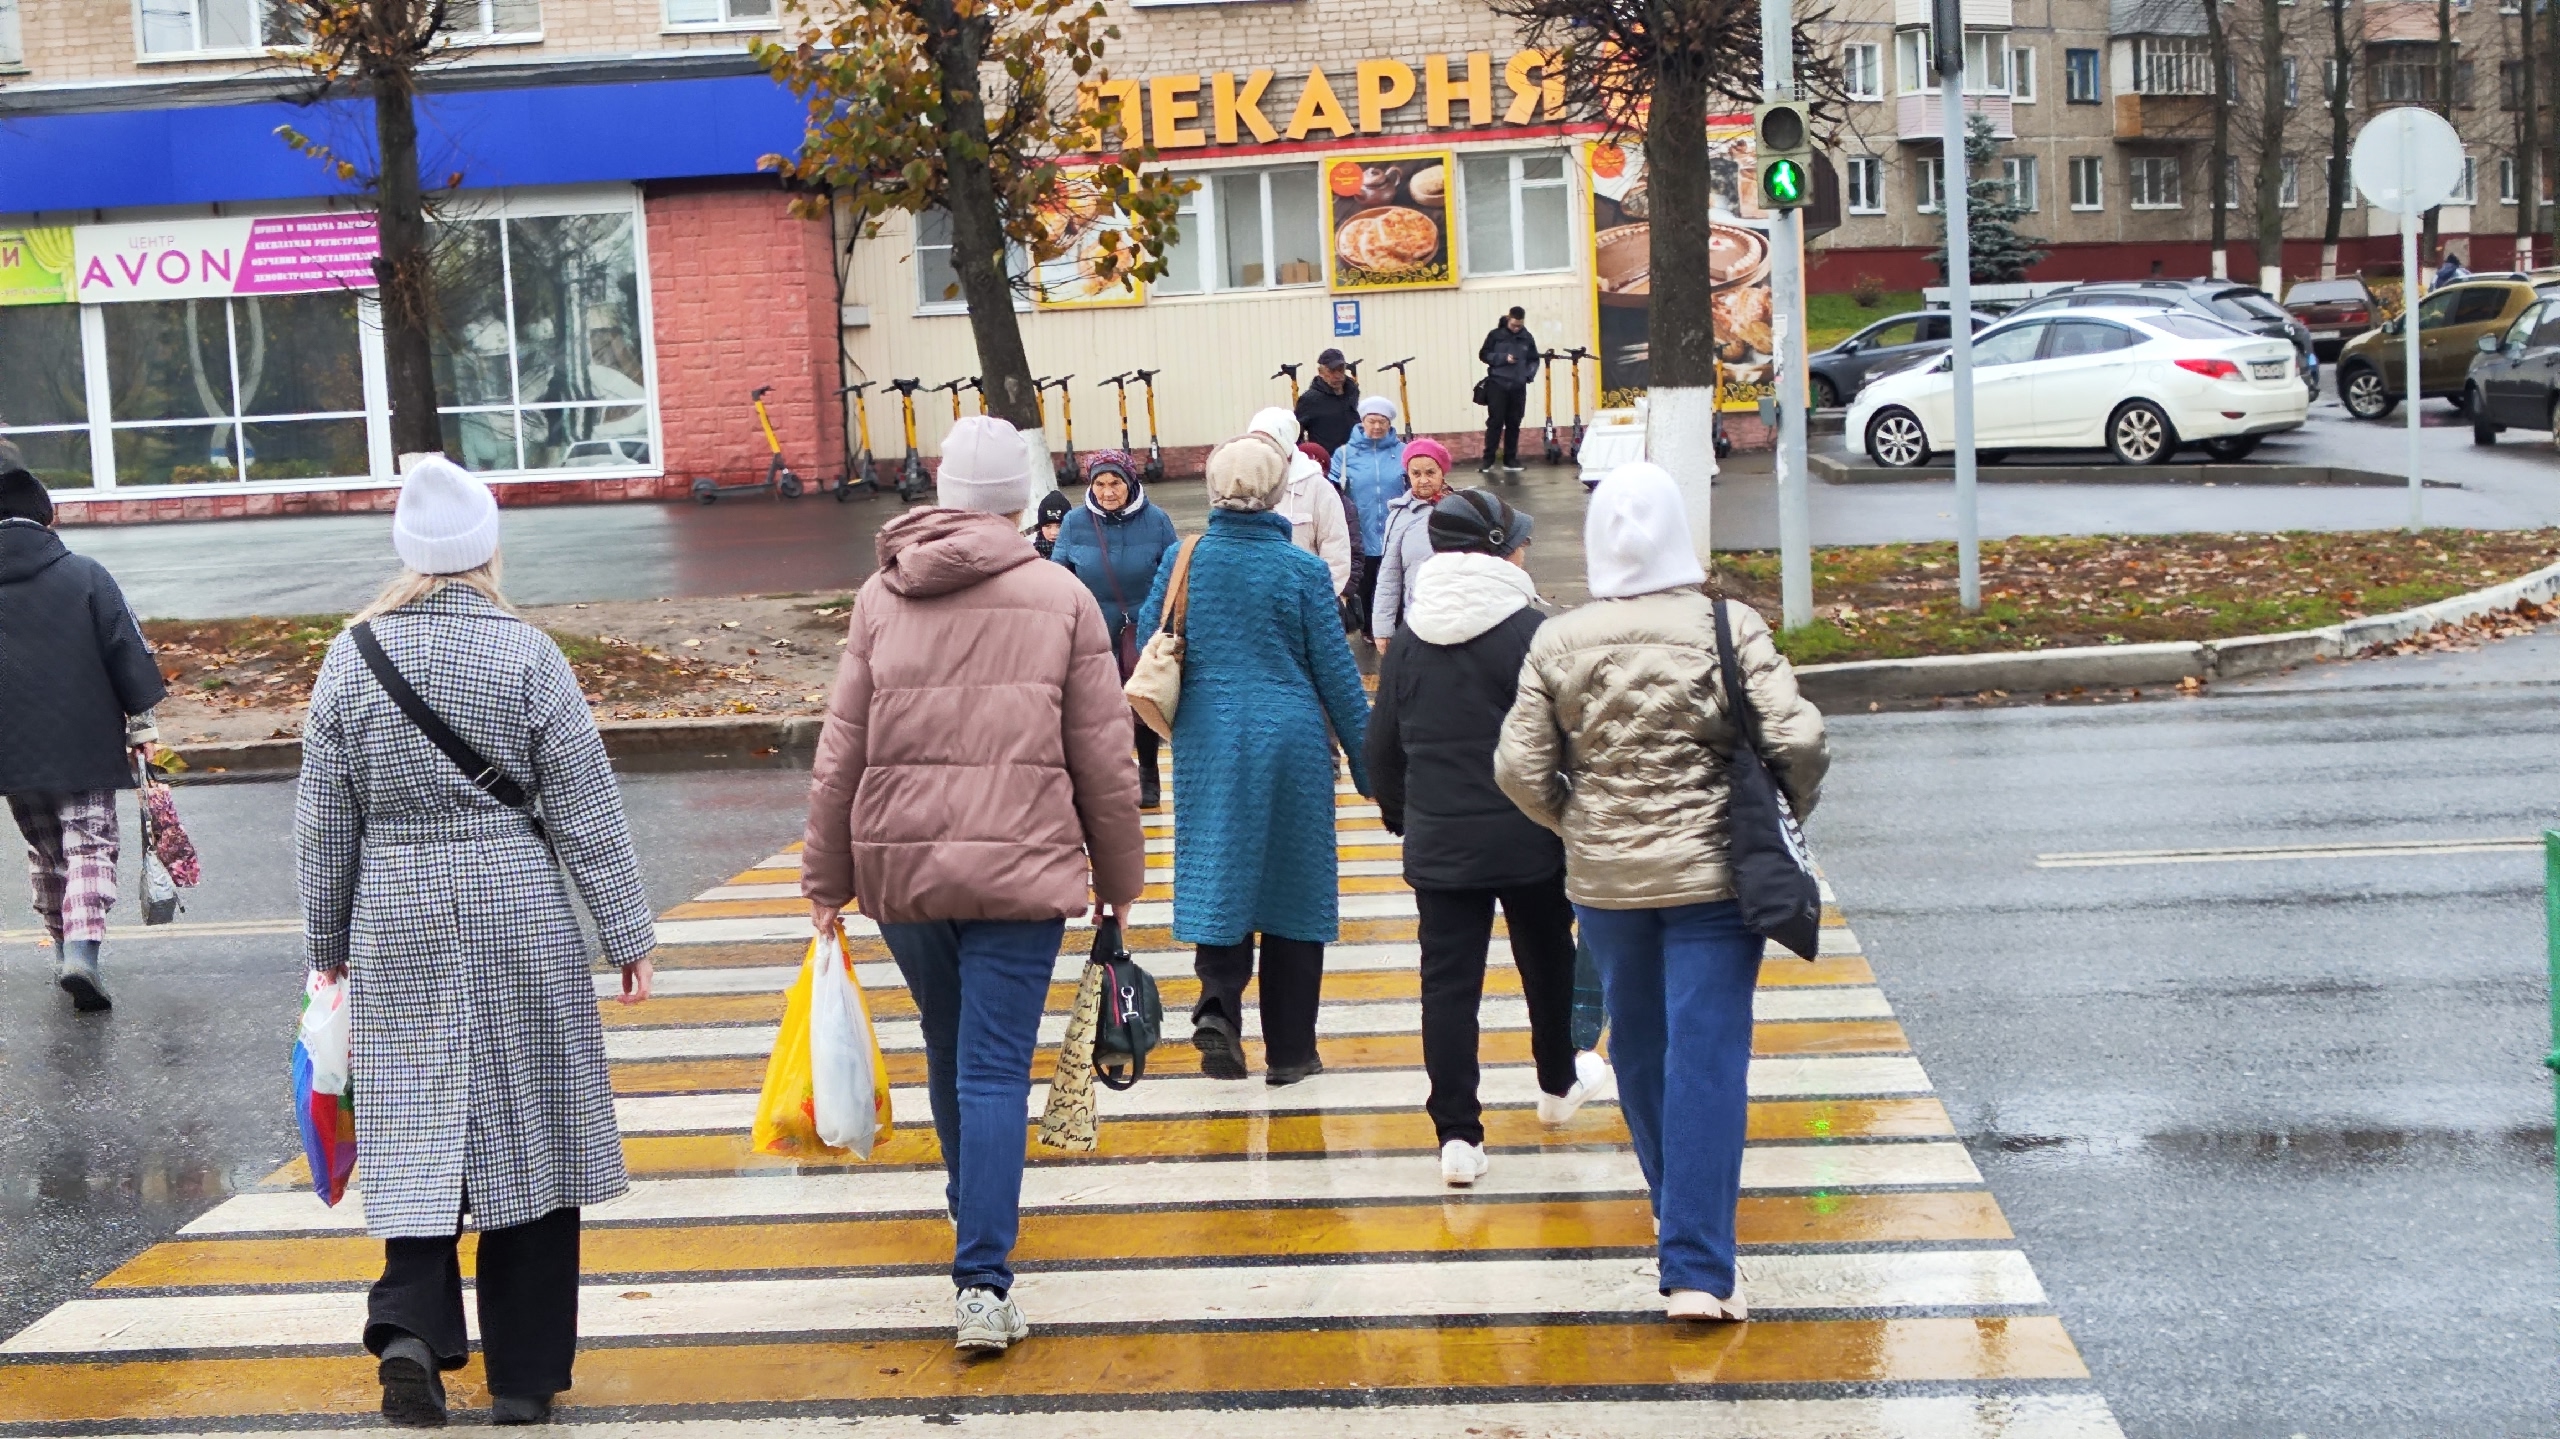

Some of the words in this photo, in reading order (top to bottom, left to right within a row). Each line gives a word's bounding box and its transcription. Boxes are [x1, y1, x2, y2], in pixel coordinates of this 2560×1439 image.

[1078, 49, 1566, 152] ПЕКАРНЯ
[129, 236, 175, 250] ЦЕНТР
[80, 248, 231, 289] AVON
